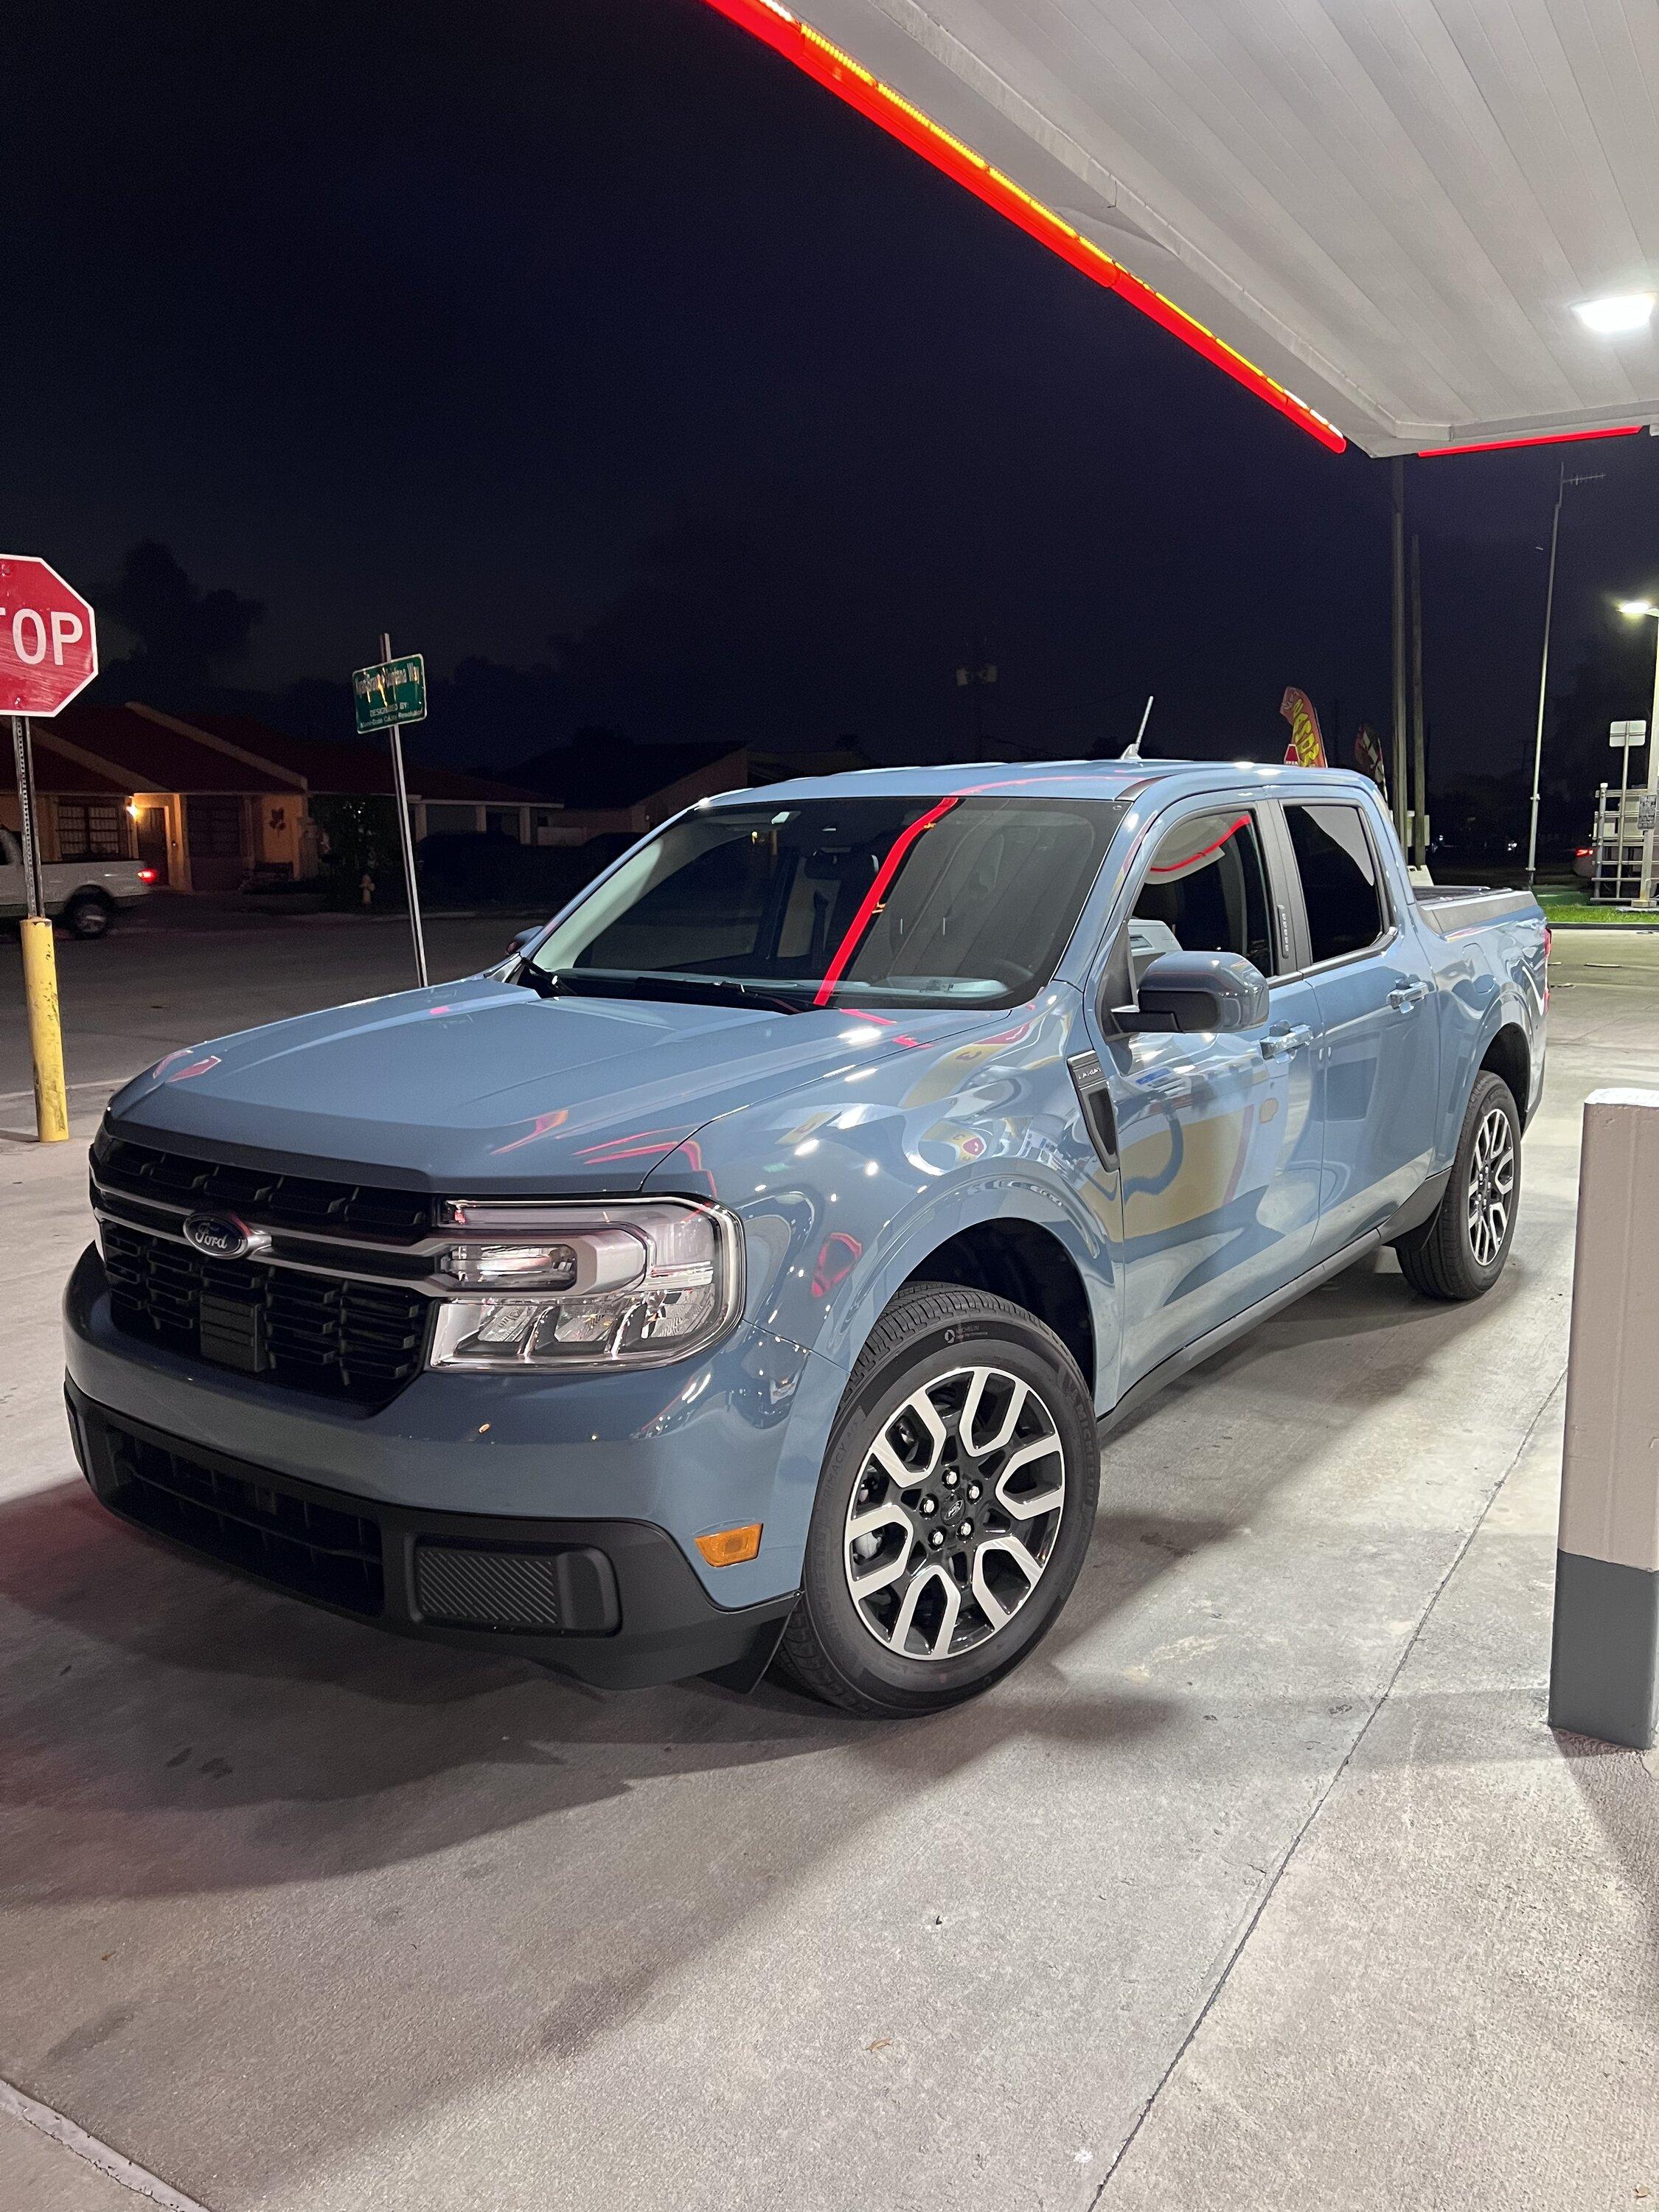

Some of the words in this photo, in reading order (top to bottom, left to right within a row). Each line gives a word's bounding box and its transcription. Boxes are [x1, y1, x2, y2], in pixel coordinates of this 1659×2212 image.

[0, 607, 83, 666] OP
[195, 1222, 229, 1249] Ford
[1075, 1403, 1096, 1502] MICHELIN
